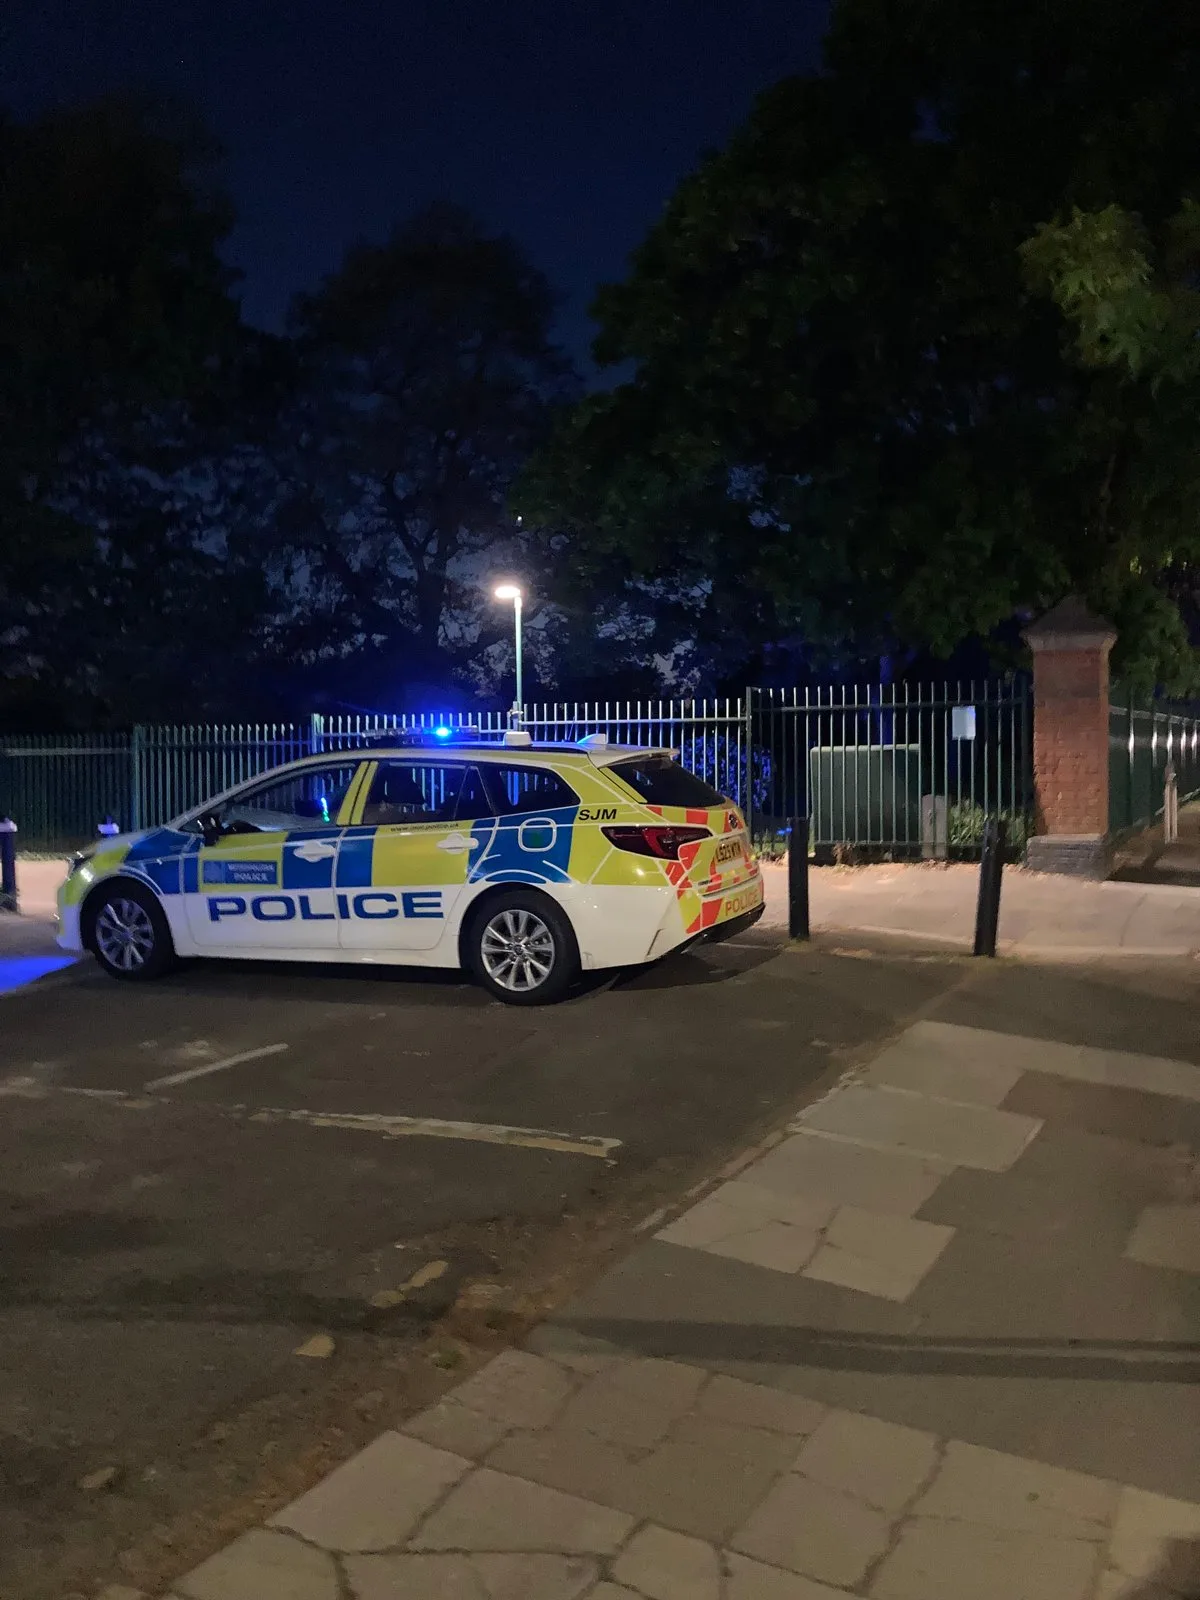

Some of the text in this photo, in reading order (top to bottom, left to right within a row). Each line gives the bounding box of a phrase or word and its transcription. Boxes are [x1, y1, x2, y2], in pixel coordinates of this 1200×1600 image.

[579, 809, 617, 820] SJM
[207, 891, 444, 922] POLICE
[725, 890, 758, 916] POLICE
